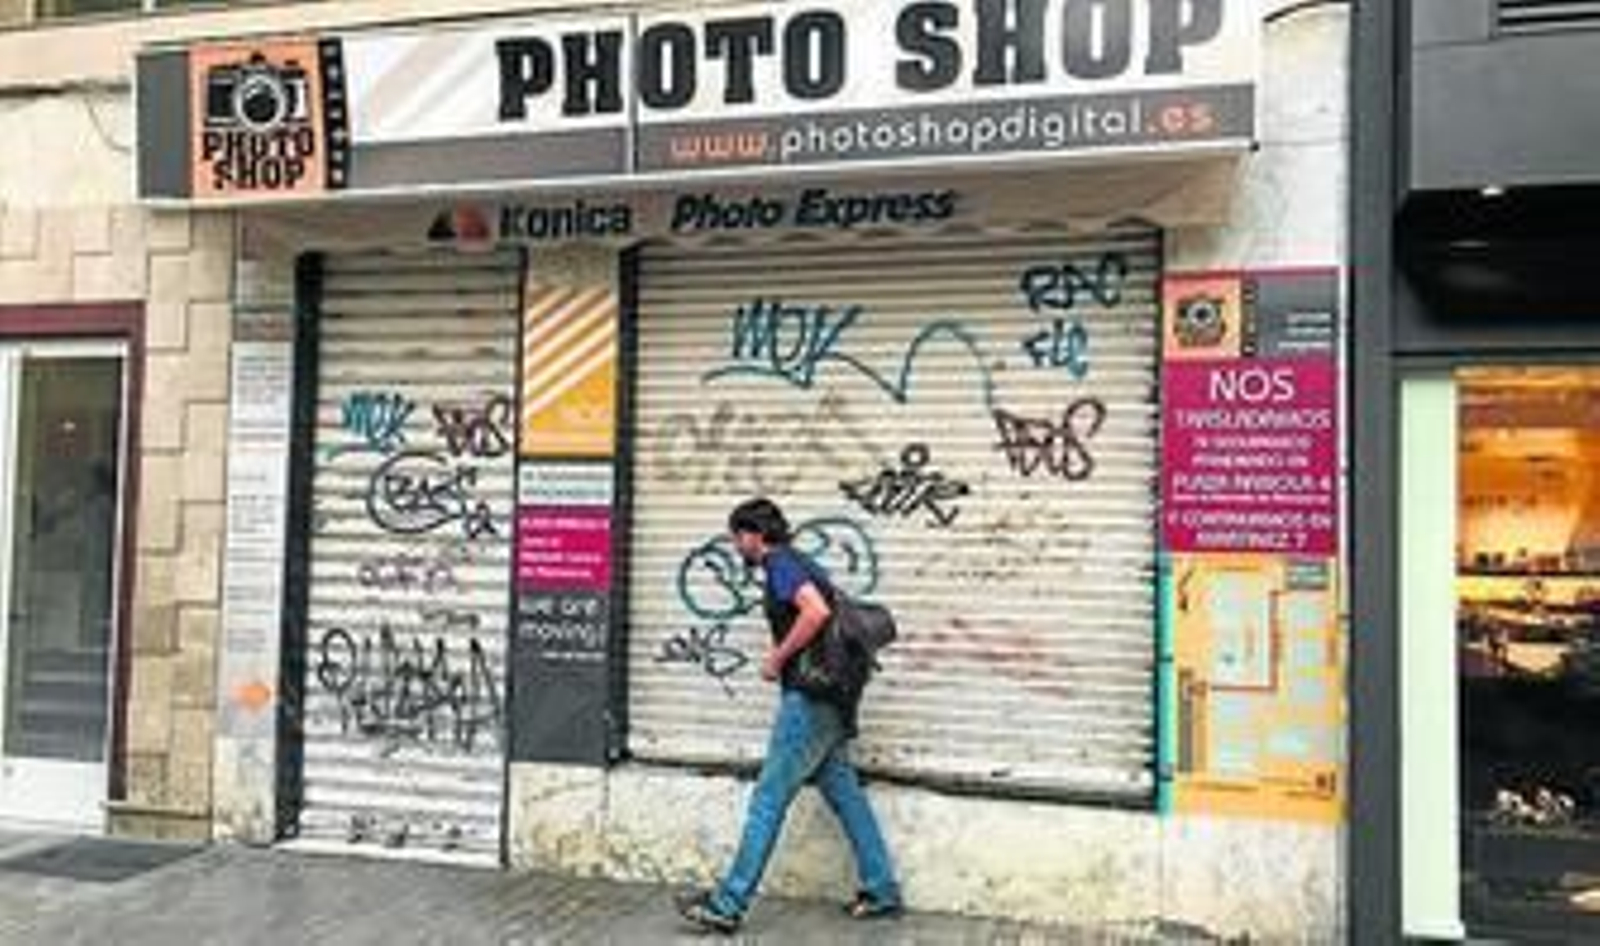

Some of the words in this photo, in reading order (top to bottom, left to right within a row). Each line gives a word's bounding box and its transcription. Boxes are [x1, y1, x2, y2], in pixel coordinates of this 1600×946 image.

[495, 9, 848, 121] PHOTO
[895, 0, 1223, 93] SHOP
[202, 128, 315, 161] PHOTO
[670, 101, 1214, 162] www.photoshopdigital.es
[212, 158, 305, 191] SHOP
[500, 198, 631, 238] Konica
[671, 193, 783, 232] Photo
[796, 187, 960, 225] Express
[1209, 368, 1295, 403] NOS
